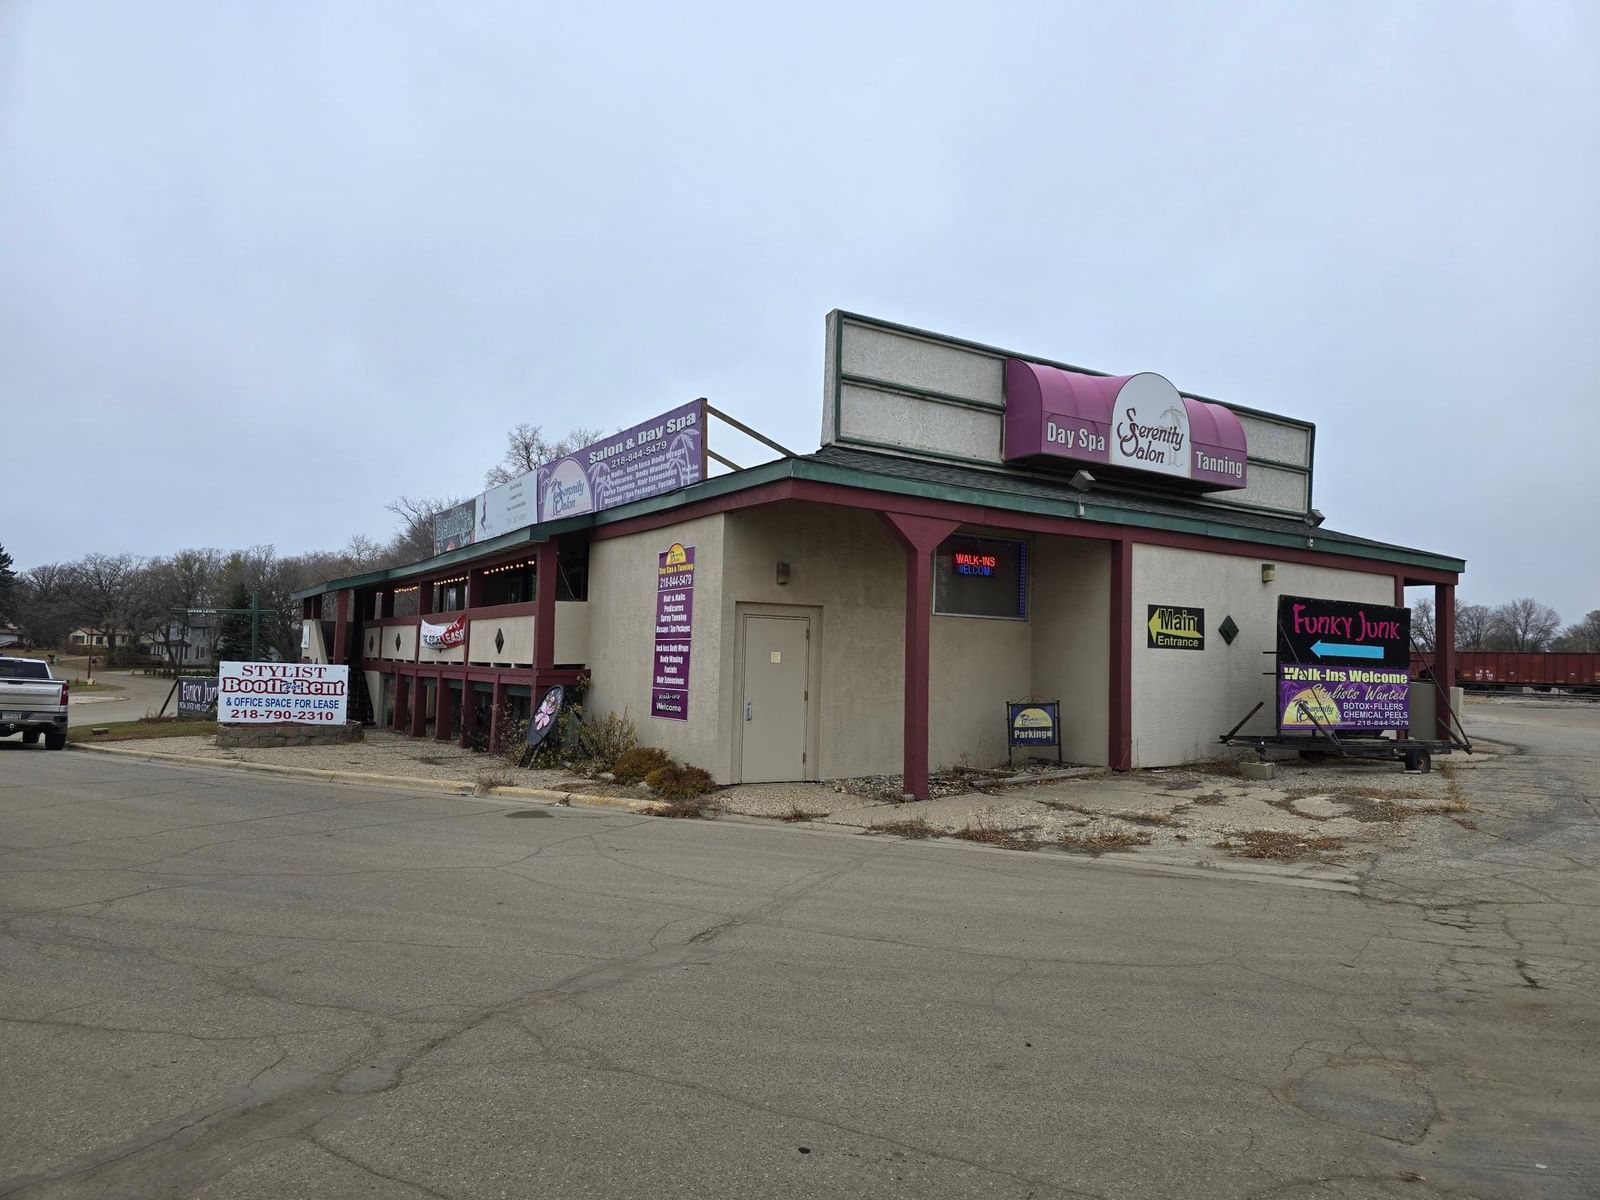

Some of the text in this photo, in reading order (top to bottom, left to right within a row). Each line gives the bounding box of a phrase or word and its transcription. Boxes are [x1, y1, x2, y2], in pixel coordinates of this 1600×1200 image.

[589, 412, 697, 464] Salon & Day Spa
[1047, 421, 1105, 452] Day Spa
[1117, 408, 1184, 452] Serenity
[611, 441, 667, 469] 218-844-5479
[1119, 437, 1165, 465] Salon
[1196, 451, 1242, 479] Tanning
[955, 553, 996, 568] WALK-INS
[1159, 608, 1198, 632] Main
[1158, 635, 1199, 647] Entrance
[242, 665, 327, 679] STYLIST
[1284, 667, 1408, 683] Walk-Ins Welcome
[222, 677, 289, 694] Booth
[293, 679, 345, 696] Rent
[1364, 685, 1408, 701] Wanted
[226, 697, 339, 709] & OFFICE SPACE FOR LEASE
[231, 710, 334, 721] 218-790-2310
[1343, 711, 1383, 719] CHEMICAL
[1015, 729, 1047, 739] Parking
